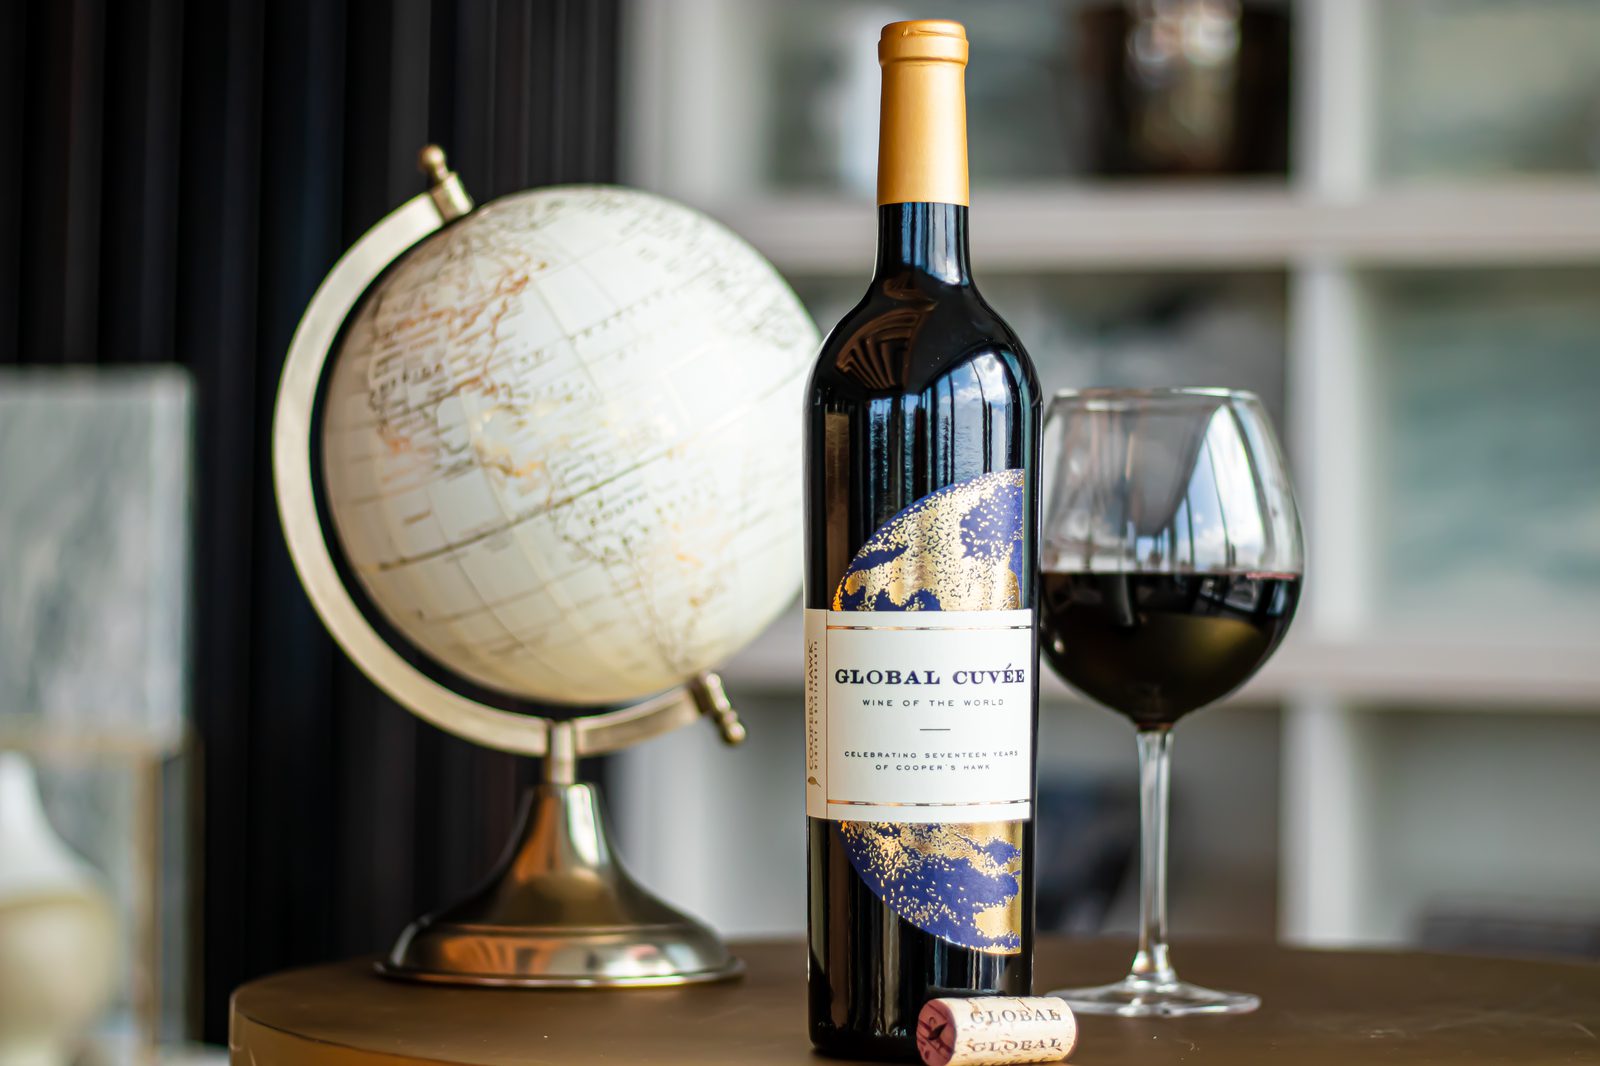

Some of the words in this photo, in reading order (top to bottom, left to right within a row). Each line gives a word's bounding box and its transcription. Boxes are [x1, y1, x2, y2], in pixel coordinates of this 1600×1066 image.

[835, 669, 940, 684] GLOBAL
[952, 663, 1024, 684] CUVÉE
[862, 699, 894, 707] WINE
[902, 699, 920, 707] OF
[929, 699, 955, 707] THE
[963, 698, 1005, 707] WORLD
[844, 750, 918, 759] CELEBRATING
[924, 751, 988, 759] SEVENTEEN
[992, 750, 1019, 758] YEARS
[875, 763, 889, 771] OF
[896, 763, 957, 771] COOPER'S
[963, 763, 991, 771] HAWK
[970, 1009, 1062, 1025] GLOBAL
[972, 1038, 1062, 1053] GLOBAL
